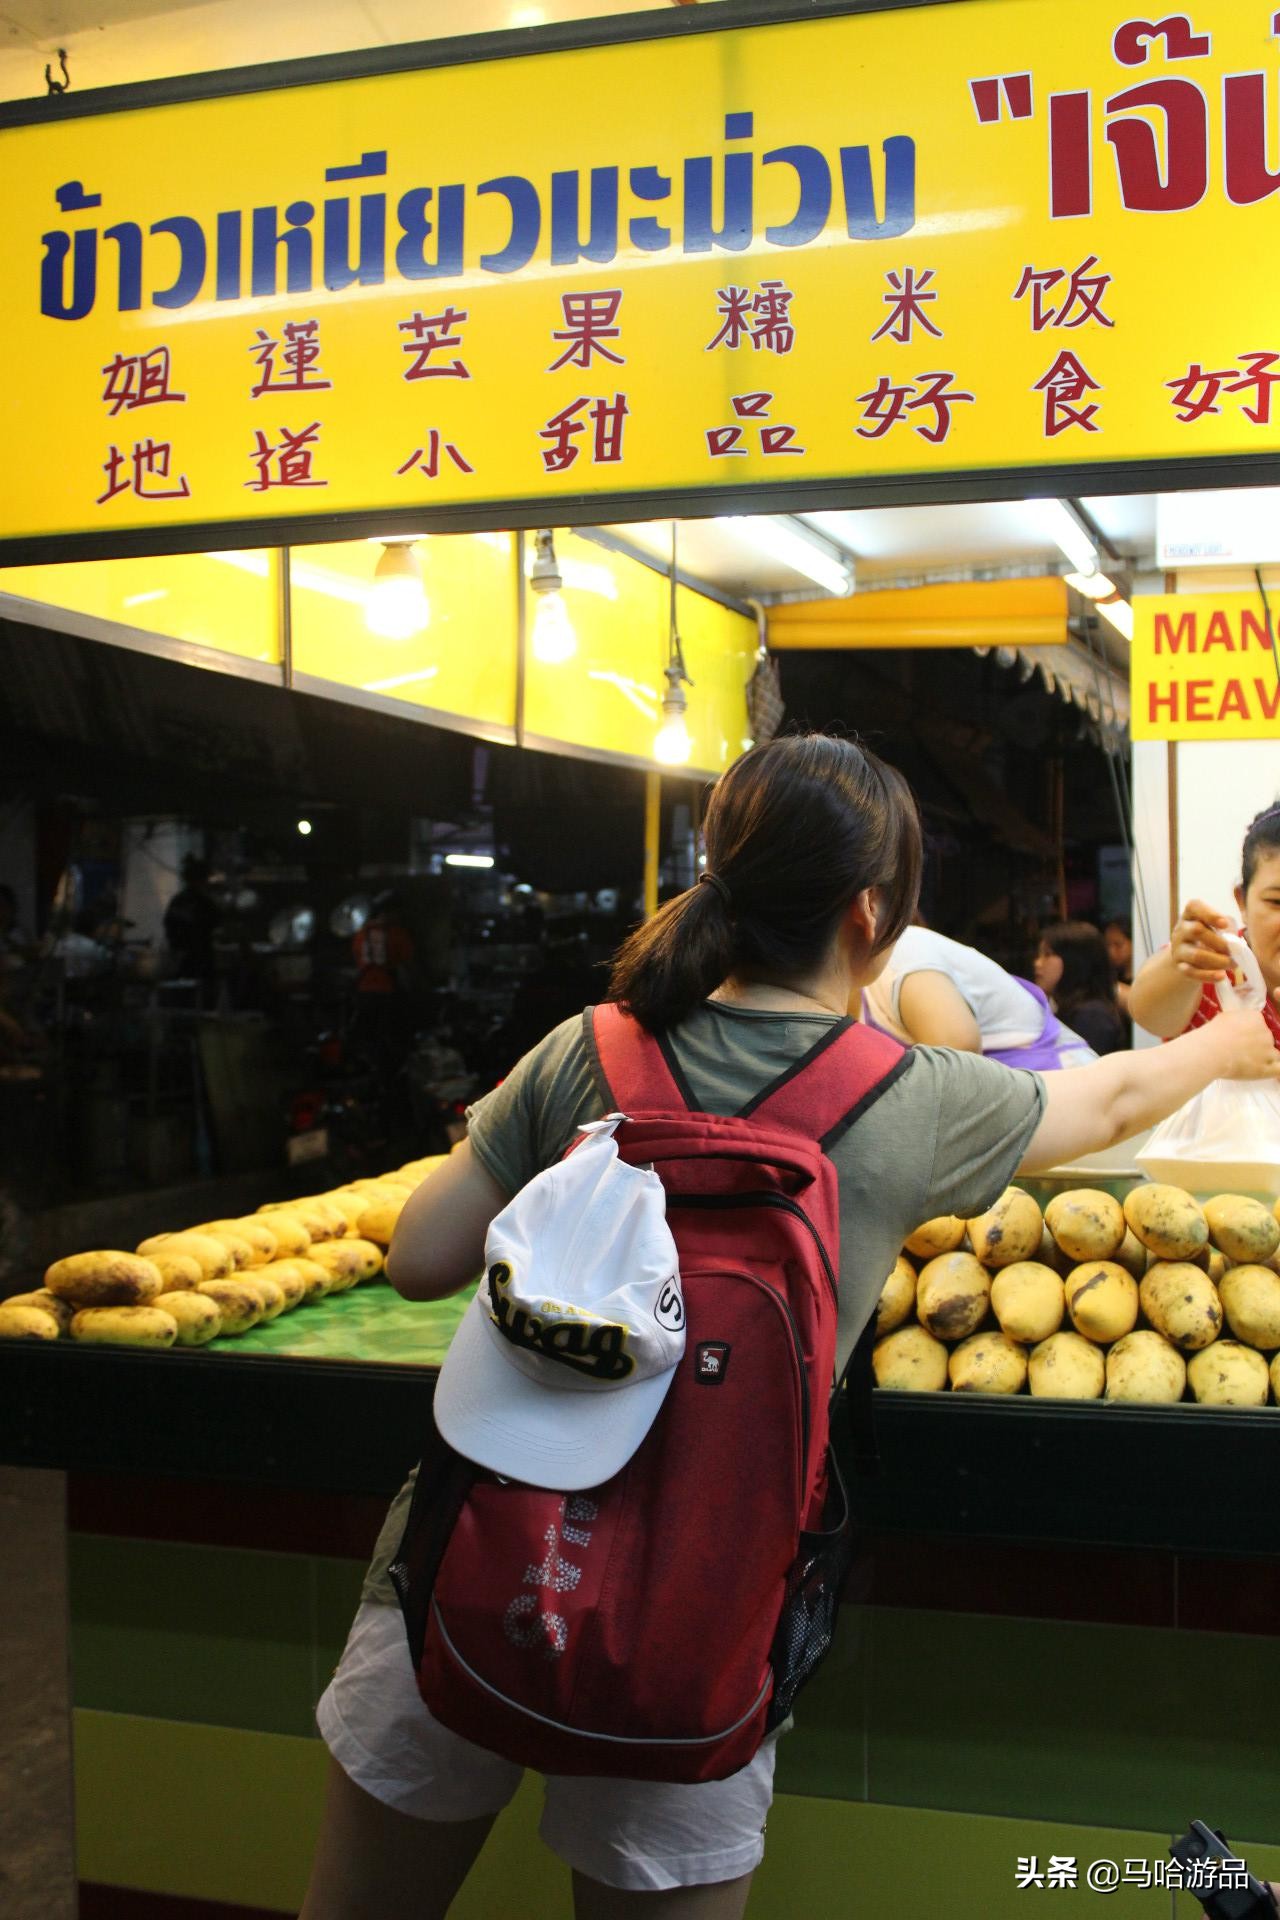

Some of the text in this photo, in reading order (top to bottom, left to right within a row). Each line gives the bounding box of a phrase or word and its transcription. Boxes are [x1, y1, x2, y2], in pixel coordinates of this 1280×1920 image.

[41, 112, 916, 320] ข้าวเหนียวมะม่วง
[1155, 609, 1280, 655] MAN
